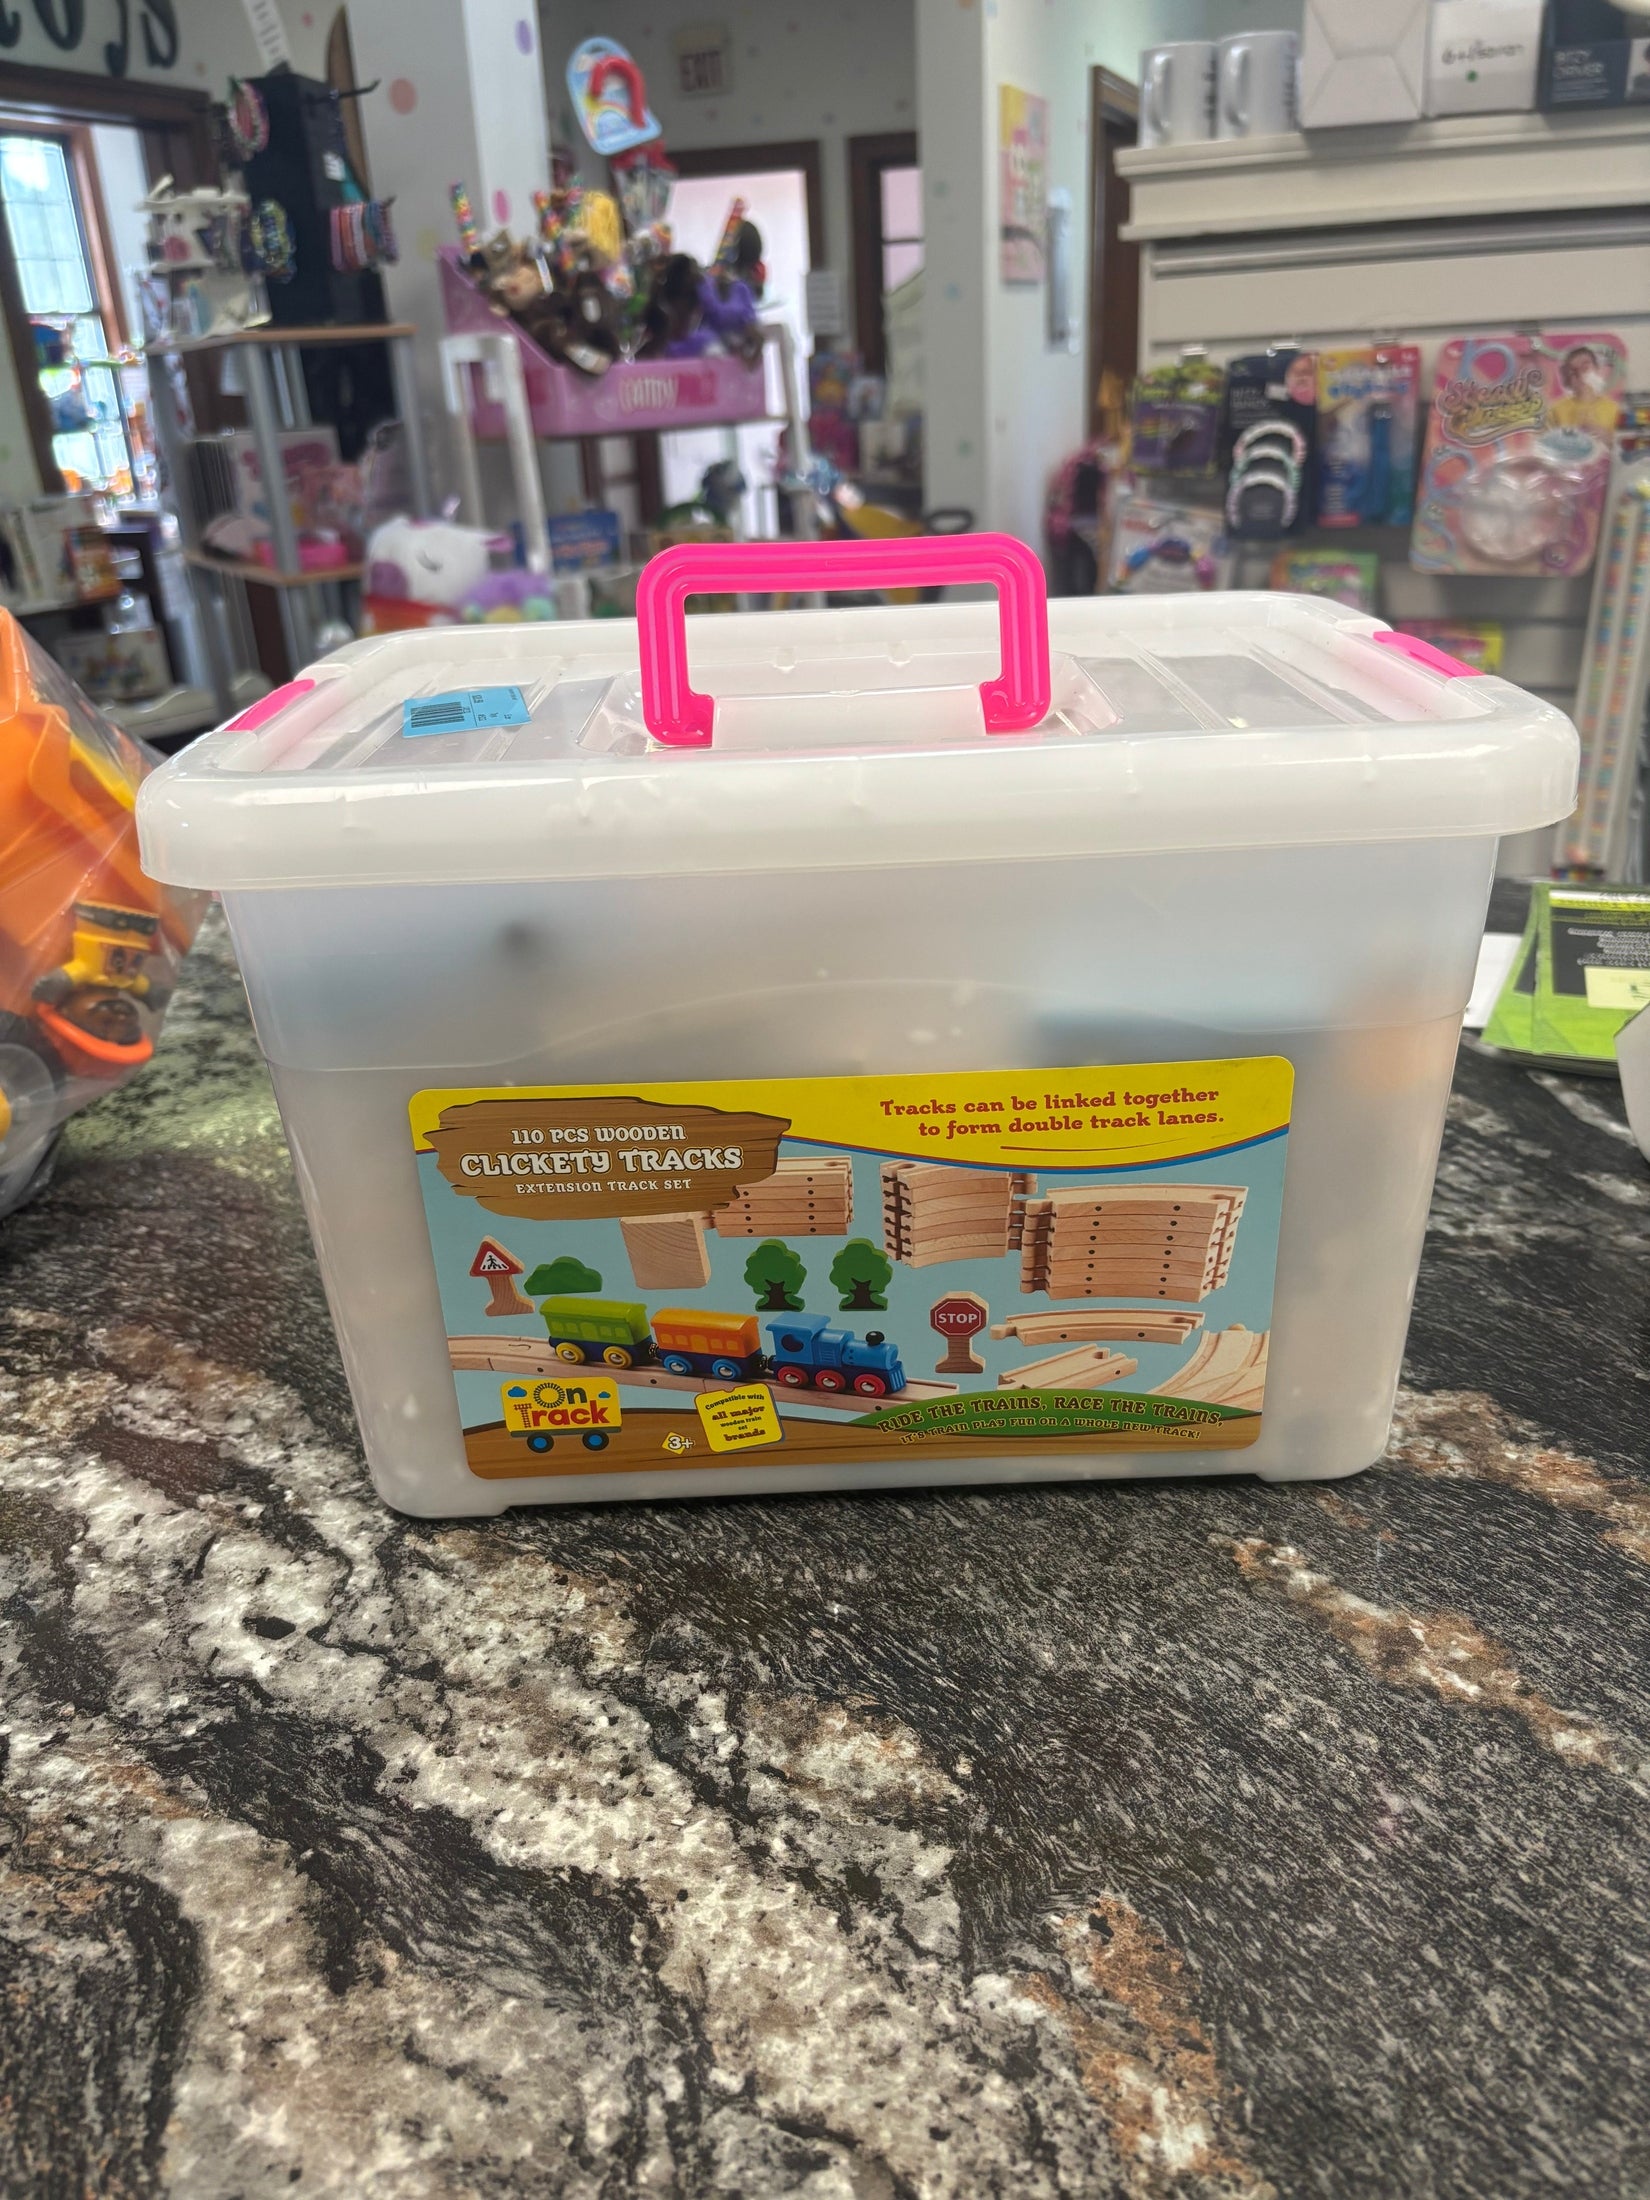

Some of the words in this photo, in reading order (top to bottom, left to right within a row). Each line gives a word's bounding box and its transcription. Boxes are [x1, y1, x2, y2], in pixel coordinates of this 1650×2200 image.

[880, 1099, 956, 1116] Tracks
[964, 1099, 1004, 1113] can
[1011, 1096, 1037, 1111] be
[1045, 1091, 1116, 1109] linked
[1123, 1087, 1219, 1108] together
[511, 1129, 544, 1145] 110
[549, 1127, 589, 1143] PCS
[594, 1125, 687, 1142] WOODEN
[918, 1121, 940, 1137] to
[946, 1120, 1001, 1139] form
[1008, 1116, 1083, 1134] double
[1090, 1112, 1149, 1129] track
[1158, 1109, 1225, 1125] lanes.
[460, 1149, 611, 1177] CLICKETY
[618, 1146, 743, 1172] TRACKS
[515, 1182, 602, 1195] EXTENSION
[607, 1179, 658, 1191] TRACK
[664, 1179, 691, 1190] SET
[938, 1311, 978, 1324] STOP
[533, 1382, 587, 1408] On
[705, 1394, 745, 1410] Compatible
[513, 1400, 610, 1428] Track
[712, 1411, 728, 1421] all
[730, 1406, 765, 1417] major
[877, 1410, 923, 1433] RIDE
[927, 1402, 965, 1420] THE
[1054, 1396, 1103, 1410] RACE
[1109, 1398, 1147, 1415] THE
[668, 1435, 694, 1450] 3+
[723, 1428, 766, 1441] brands
[900, 1431, 925, 1445] IT'S
[927, 1422, 969, 1437] TRAIN
[972, 1418, 1006, 1429] PLAY
[1010, 1417, 1036, 1426] FUN
[1038, 1417, 1057, 1426] ON
[1060, 1417, 1071, 1426] A
[1074, 1417, 1119, 1429] WHOLE
[1122, 1421, 1151, 1432] NEW
[1155, 1425, 1201, 1440] TRACK!
